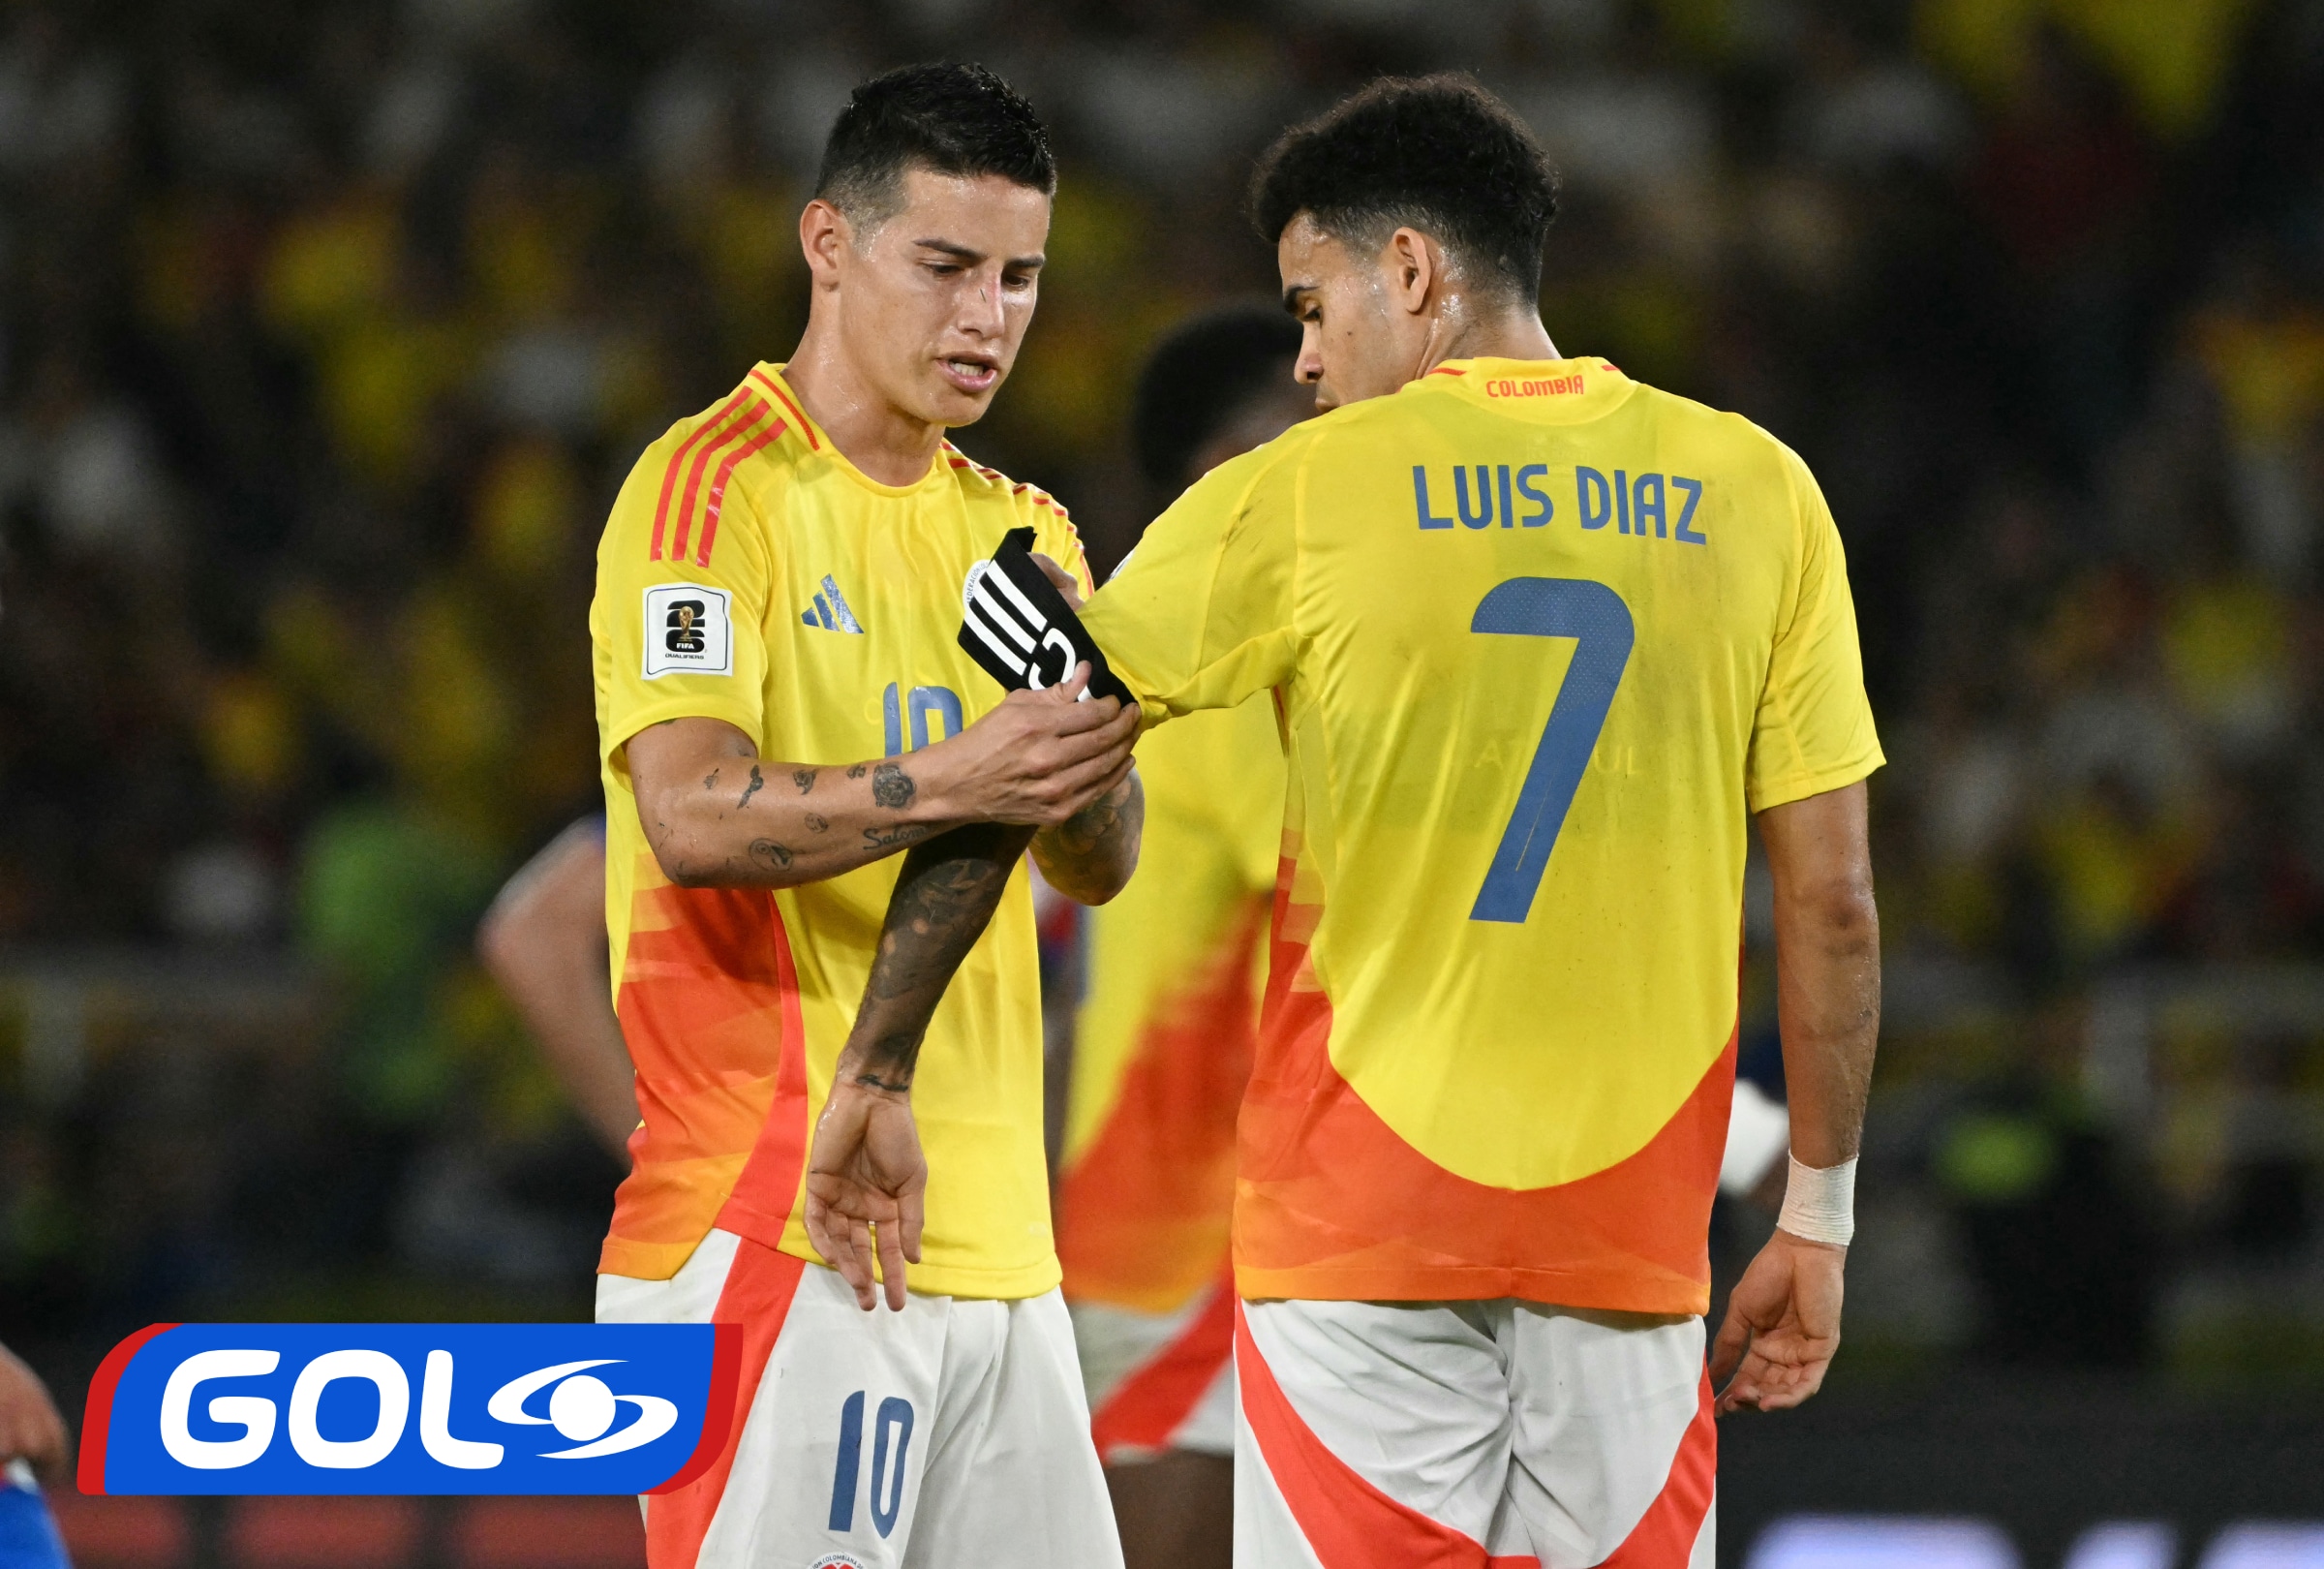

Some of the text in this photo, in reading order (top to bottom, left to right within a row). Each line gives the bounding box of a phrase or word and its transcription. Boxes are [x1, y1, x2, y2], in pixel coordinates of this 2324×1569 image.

[1485, 375, 1584, 398] COLOMBIA
[1412, 464, 1707, 545] LUIS DIAZ
[883, 681, 963, 758] 10
[1468, 576, 1635, 924] 7
[828, 1390, 915, 1539] 10
